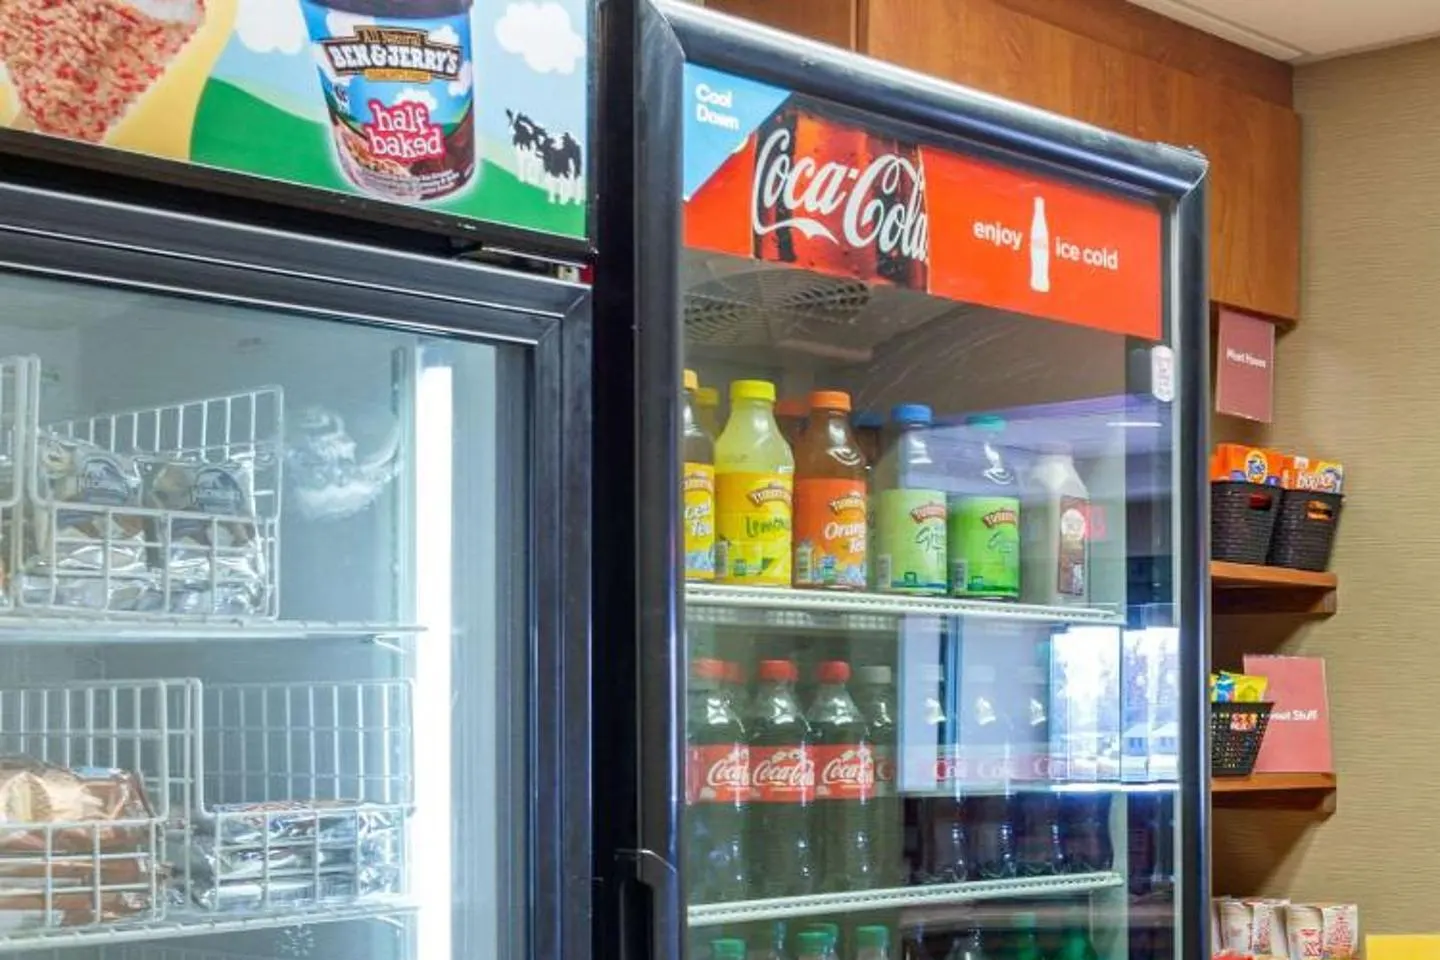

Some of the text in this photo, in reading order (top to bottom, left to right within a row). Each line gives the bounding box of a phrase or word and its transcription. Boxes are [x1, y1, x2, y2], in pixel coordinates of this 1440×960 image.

[695, 83, 733, 108] Cool
[371, 103, 428, 135] half
[696, 106, 740, 131] Down
[366, 127, 442, 158] baked
[752, 128, 928, 261] Coca-Cola
[973, 221, 1118, 270] enjoy ice cold
